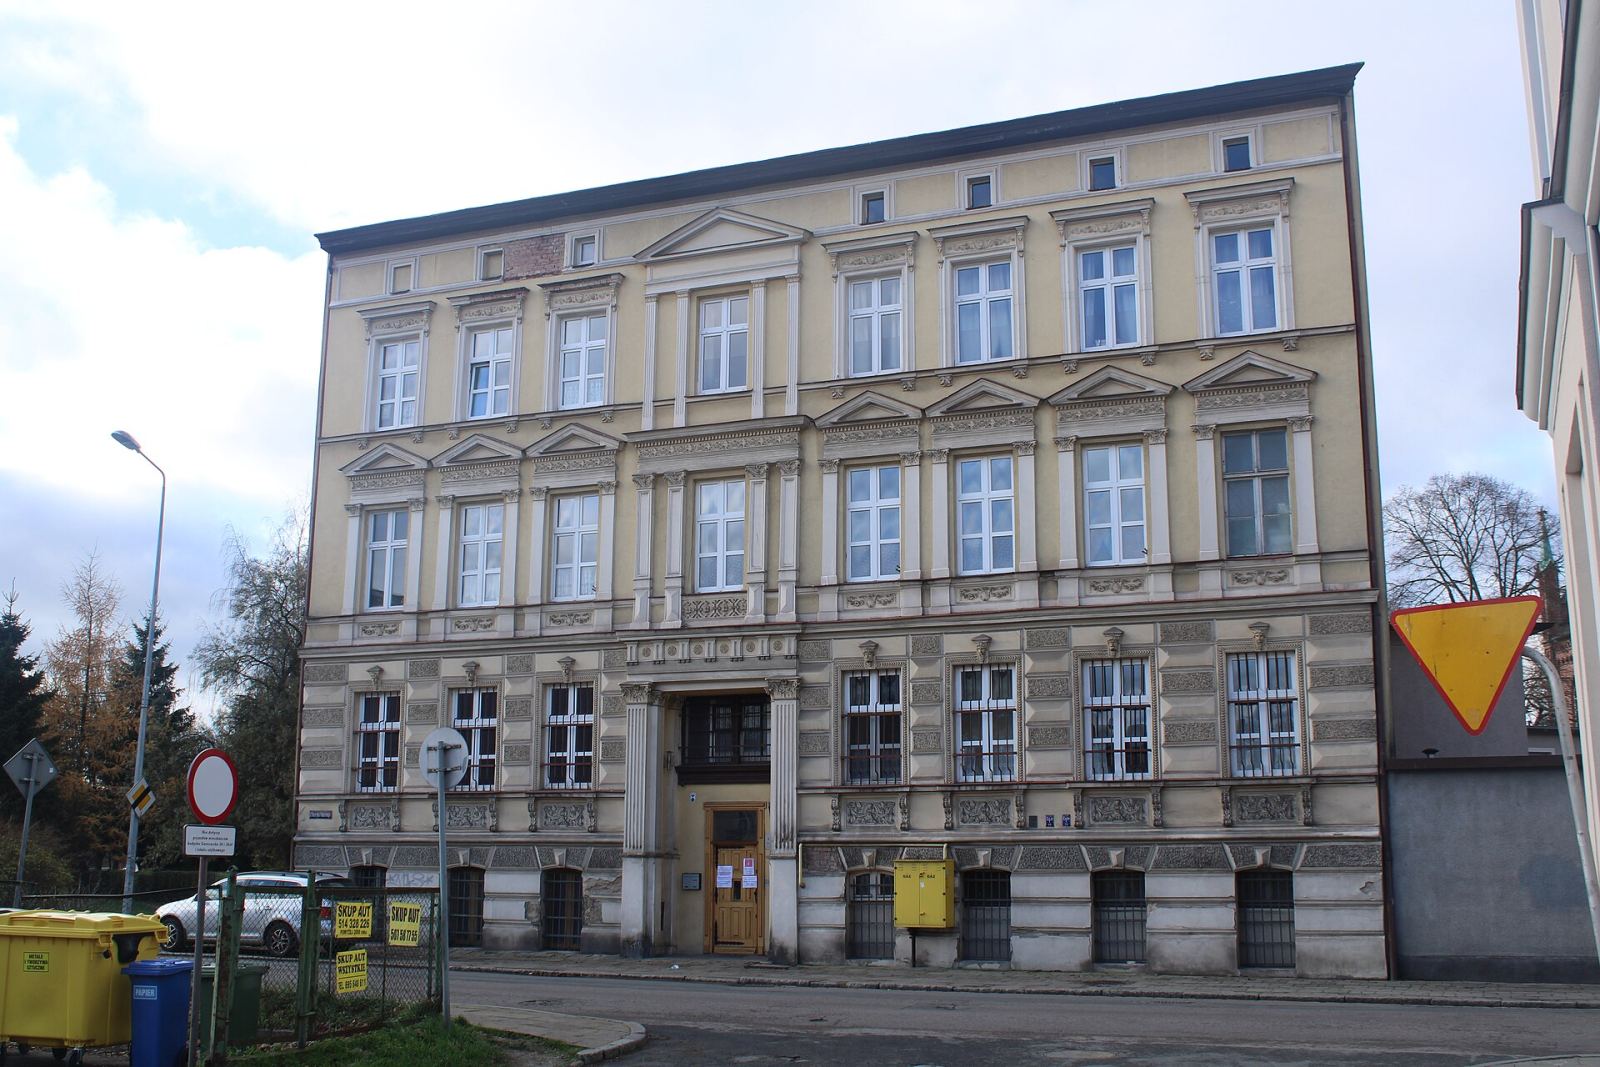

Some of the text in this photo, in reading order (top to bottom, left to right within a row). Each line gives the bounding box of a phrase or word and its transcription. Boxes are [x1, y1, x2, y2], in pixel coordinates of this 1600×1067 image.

[338, 905, 370, 917] SKUP AUT
[391, 906, 420, 923] SKUP AUT
[338, 918, 348, 929] 514
[337, 953, 365, 964] SKUP AUT
[337, 963, 366, 974] WSZYSTKIE
[135, 988, 155, 997] PAPIER
